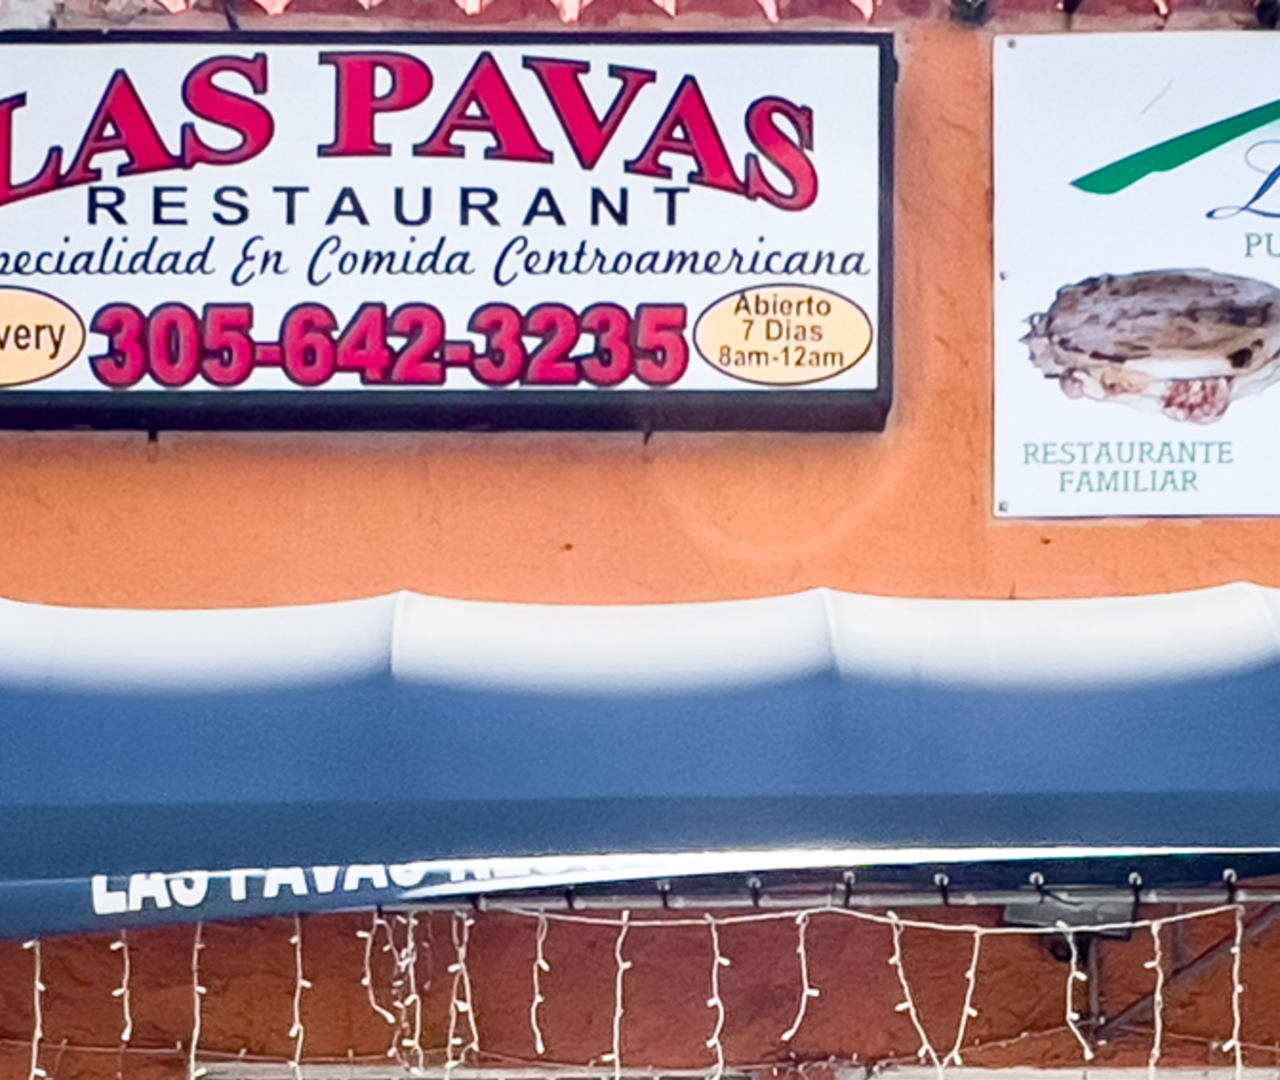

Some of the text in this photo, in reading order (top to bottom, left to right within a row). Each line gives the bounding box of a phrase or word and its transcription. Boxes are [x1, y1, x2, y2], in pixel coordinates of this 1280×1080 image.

[317, 50, 820, 213] PAVAS
[86, 186, 691, 228] RESTAURANT
[231, 238, 289, 278] En
[307, 236, 476, 287] Comida
[493, 236, 871, 287] Centroamericana
[733, 293, 832, 316] Abierto
[742, 319, 755, 341] 7
[87, 302, 689, 389] 305-642-3235
[718, 344, 845, 367] 8am-12am
[1022, 440, 1234, 466] RESTAURANTE
[1058, 469, 1199, 494] FAMILIAR
